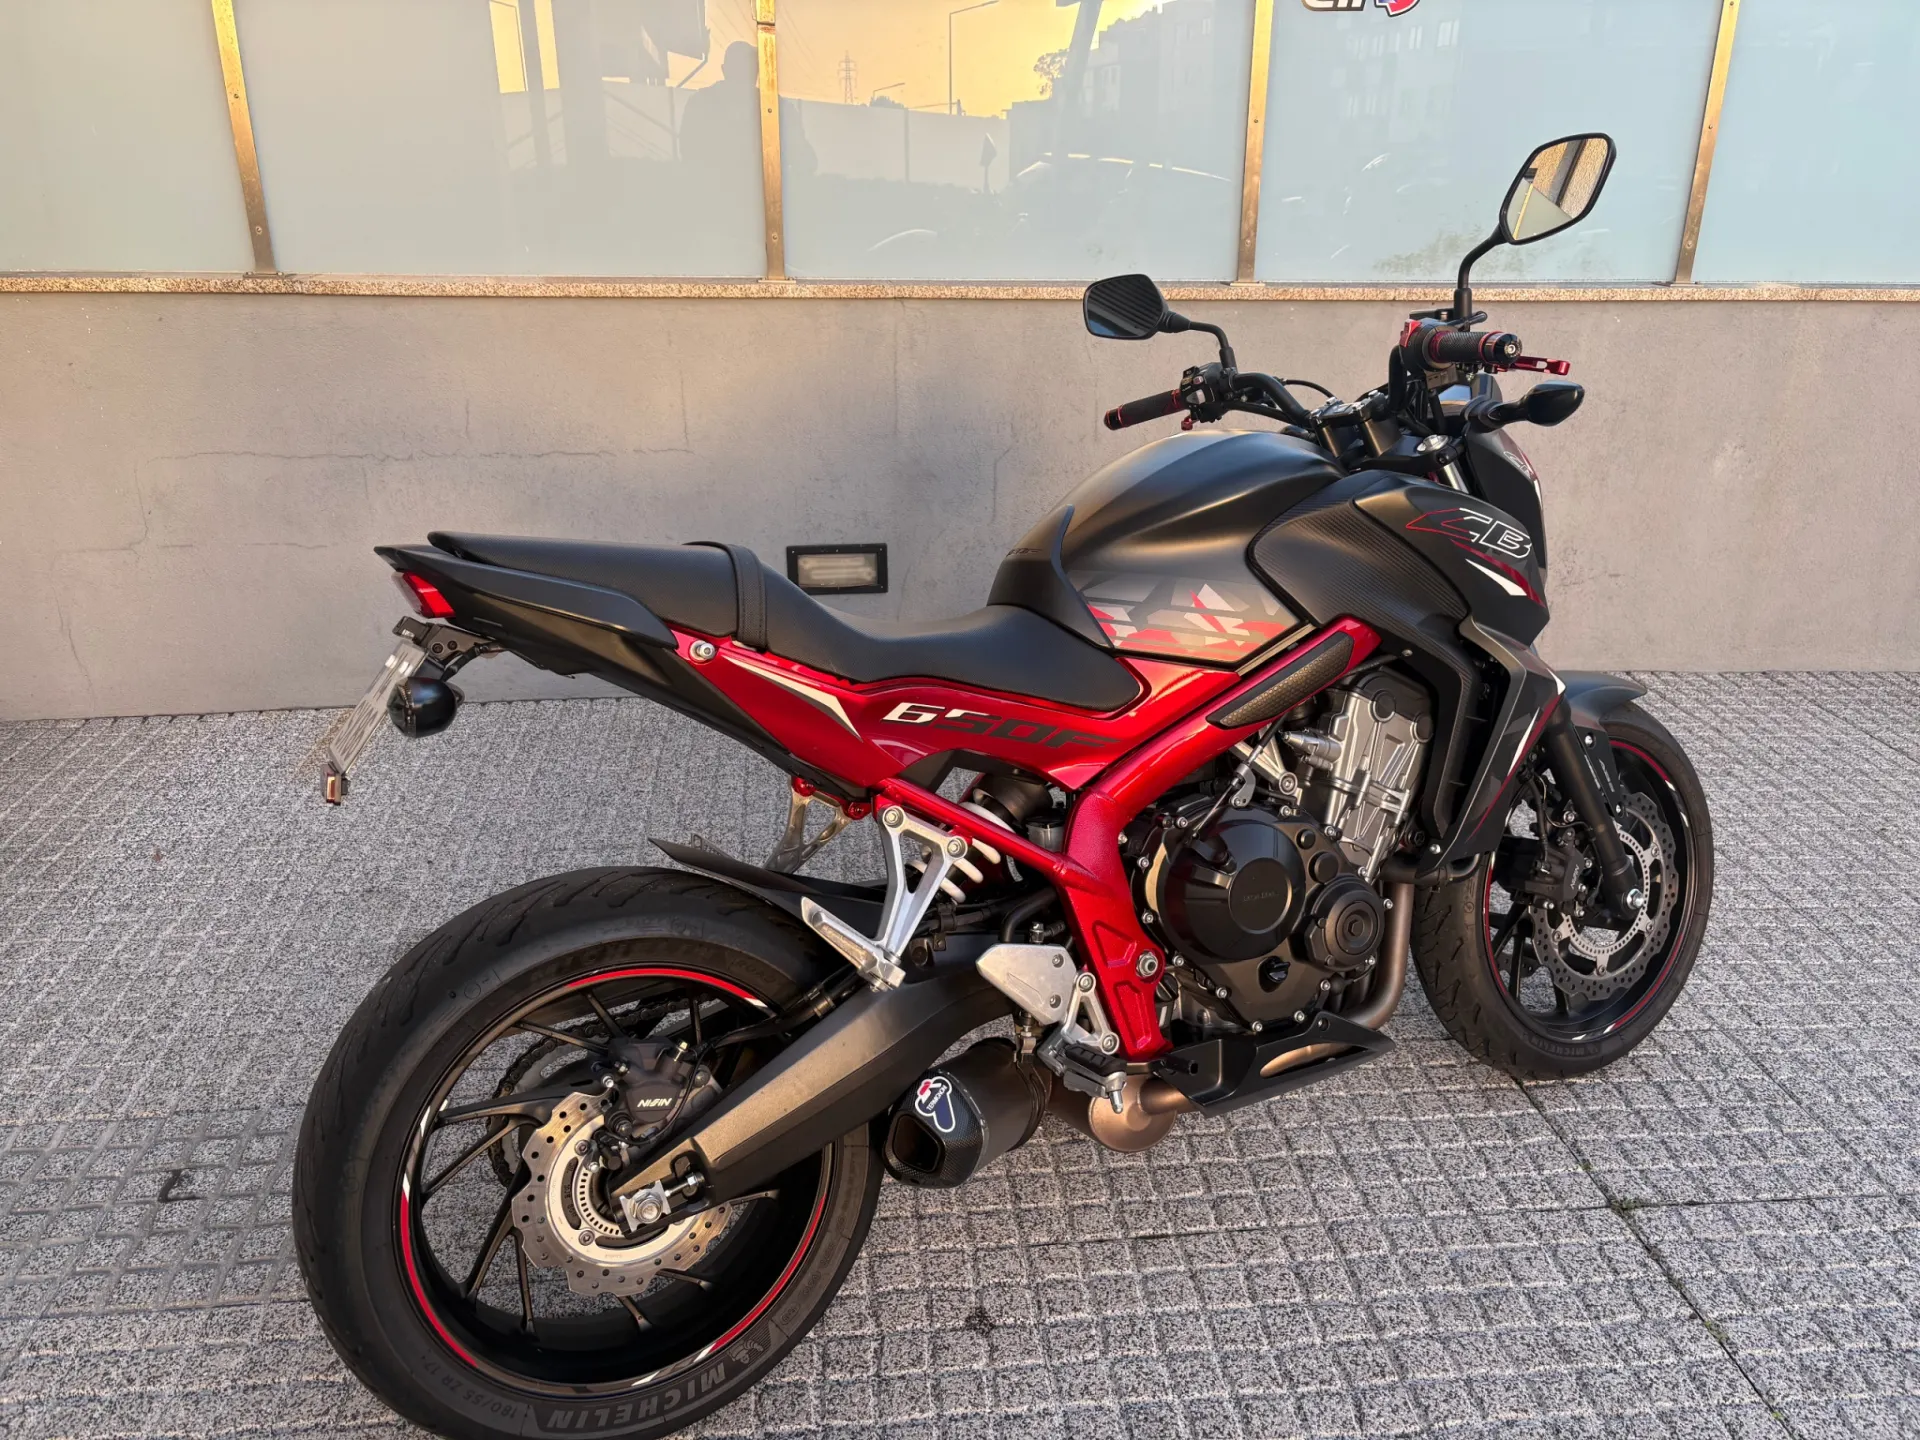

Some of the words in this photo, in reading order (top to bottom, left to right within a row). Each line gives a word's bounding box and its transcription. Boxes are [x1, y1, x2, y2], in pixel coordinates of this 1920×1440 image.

[879, 701, 1121, 748] 650F
[424, 1361, 442, 1376] 17
[442, 1374, 464, 1392] ZR
[463, 1388, 518, 1419] 180/55
[546, 1362, 726, 1429] MICHELIN
